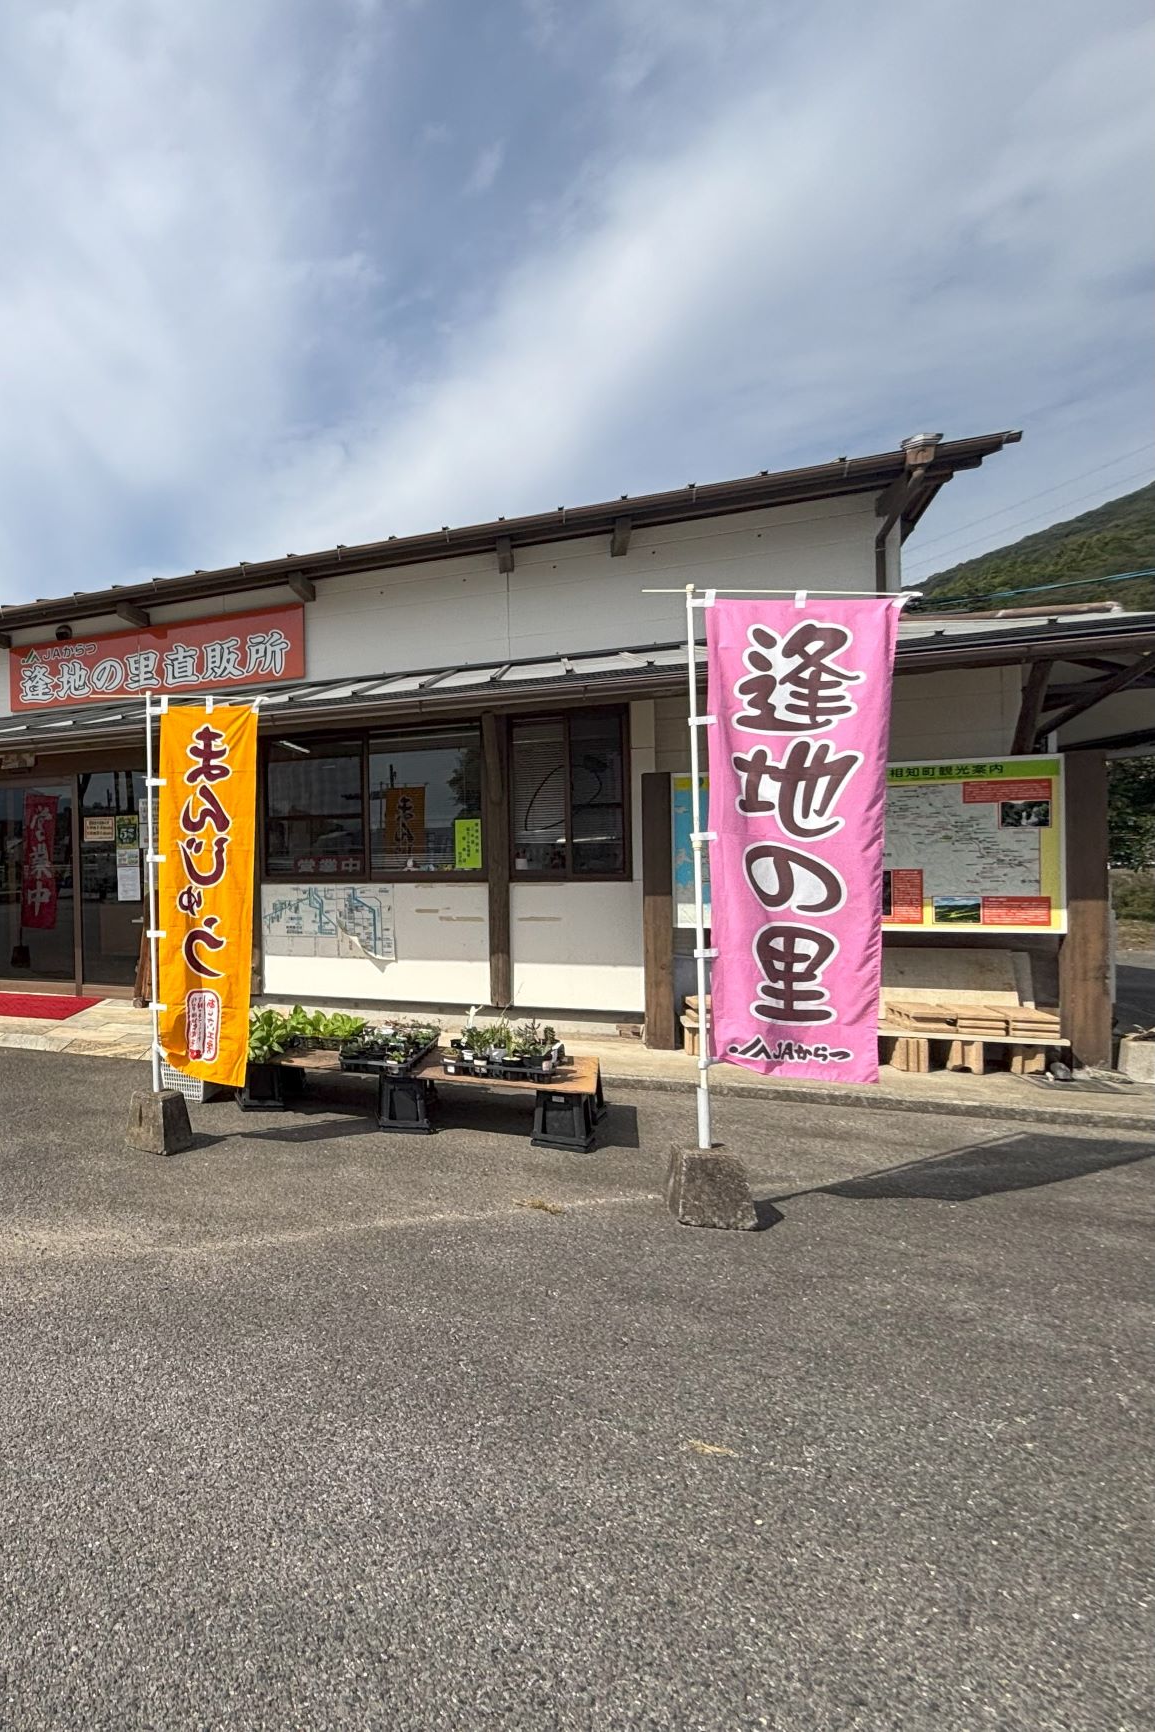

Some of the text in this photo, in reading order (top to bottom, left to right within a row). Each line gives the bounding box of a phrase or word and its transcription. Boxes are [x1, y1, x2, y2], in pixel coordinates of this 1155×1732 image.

[20, 630, 290, 703] 逢地の里直販所
[43, 643, 97, 661] JAからつ
[890, 764, 1004, 778] 相知町観光案内
[733, 619, 866, 1025] 逢地の里
[177, 723, 233, 979] まんじゅう
[772, 1041, 851, 1061] JAからつ
